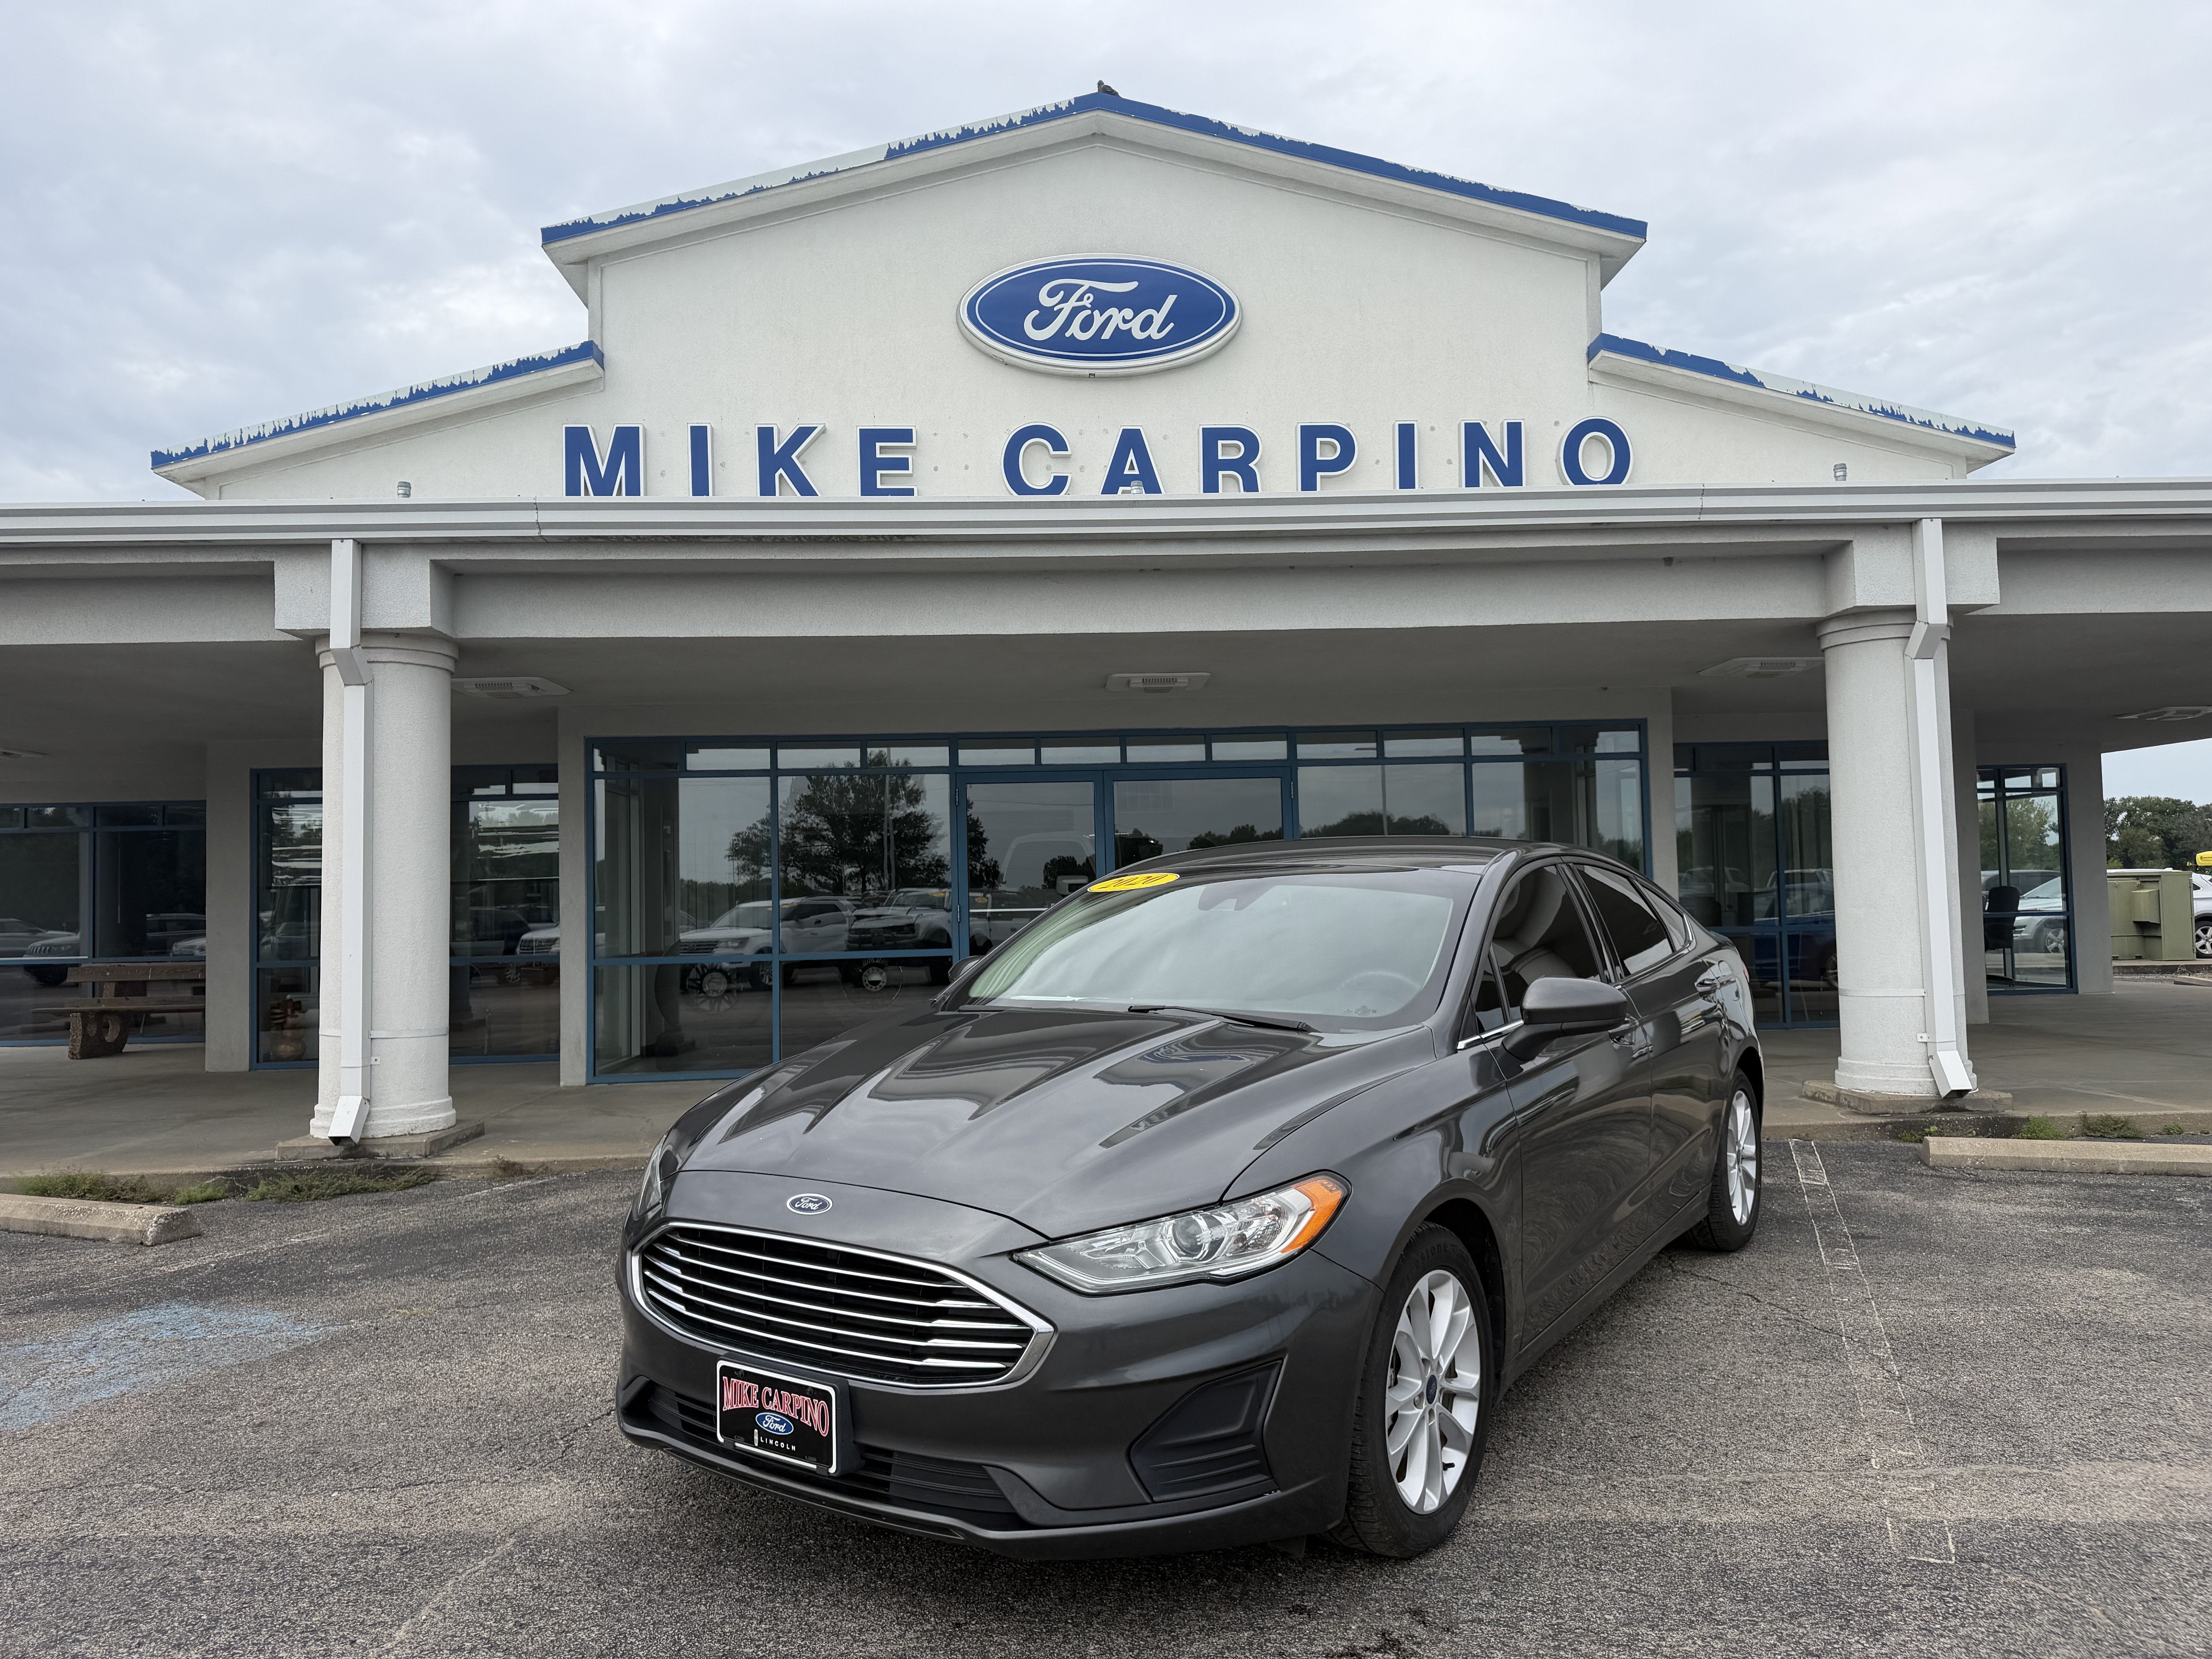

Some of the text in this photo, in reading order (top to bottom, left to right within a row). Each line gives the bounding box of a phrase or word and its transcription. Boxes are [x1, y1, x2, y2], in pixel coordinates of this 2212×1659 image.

[1024, 278, 1178, 340] Ford
[562, 416, 1634, 496] MIKE CARPINO
[1096, 874, 1168, 890] 2020
[795, 1197, 823, 1210] Ford
[723, 1376, 829, 1437] MIKE CARPINO
[763, 1415, 787, 1432] Ford
[760, 1437, 796, 1451] LINCOLN
